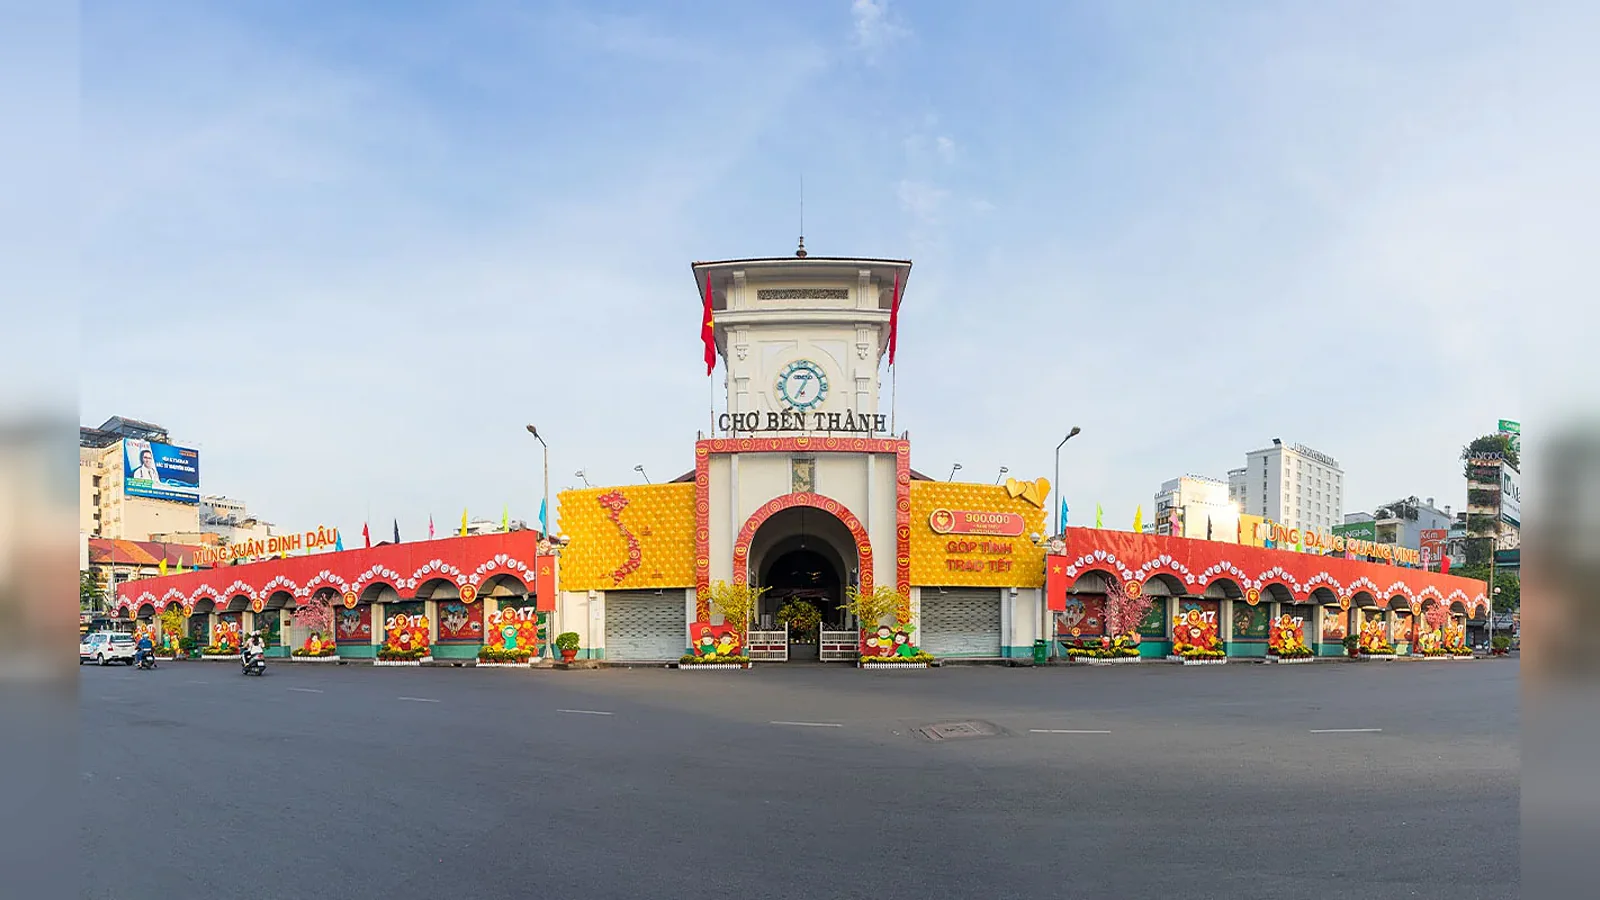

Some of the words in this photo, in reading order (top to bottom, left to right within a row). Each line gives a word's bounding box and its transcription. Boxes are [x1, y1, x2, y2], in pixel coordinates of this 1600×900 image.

[718, 410, 760, 433] CHỢ
[767, 406, 806, 431] BẾN
[813, 409, 887, 432] THÀNH
[965, 513, 1010, 523] 900.000
[230, 538, 264, 559] XUÂN
[268, 532, 301, 554] ĐINH
[306, 525, 337, 550] DẬU
[947, 538, 977, 553] GÓP
[980, 540, 1012, 554] TÌNH
[1346, 538, 1392, 560] QUANG
[1393, 545, 1419, 565] VINH
[946, 559, 985, 572] TRAO
[988, 557, 1013, 572] TẾT
